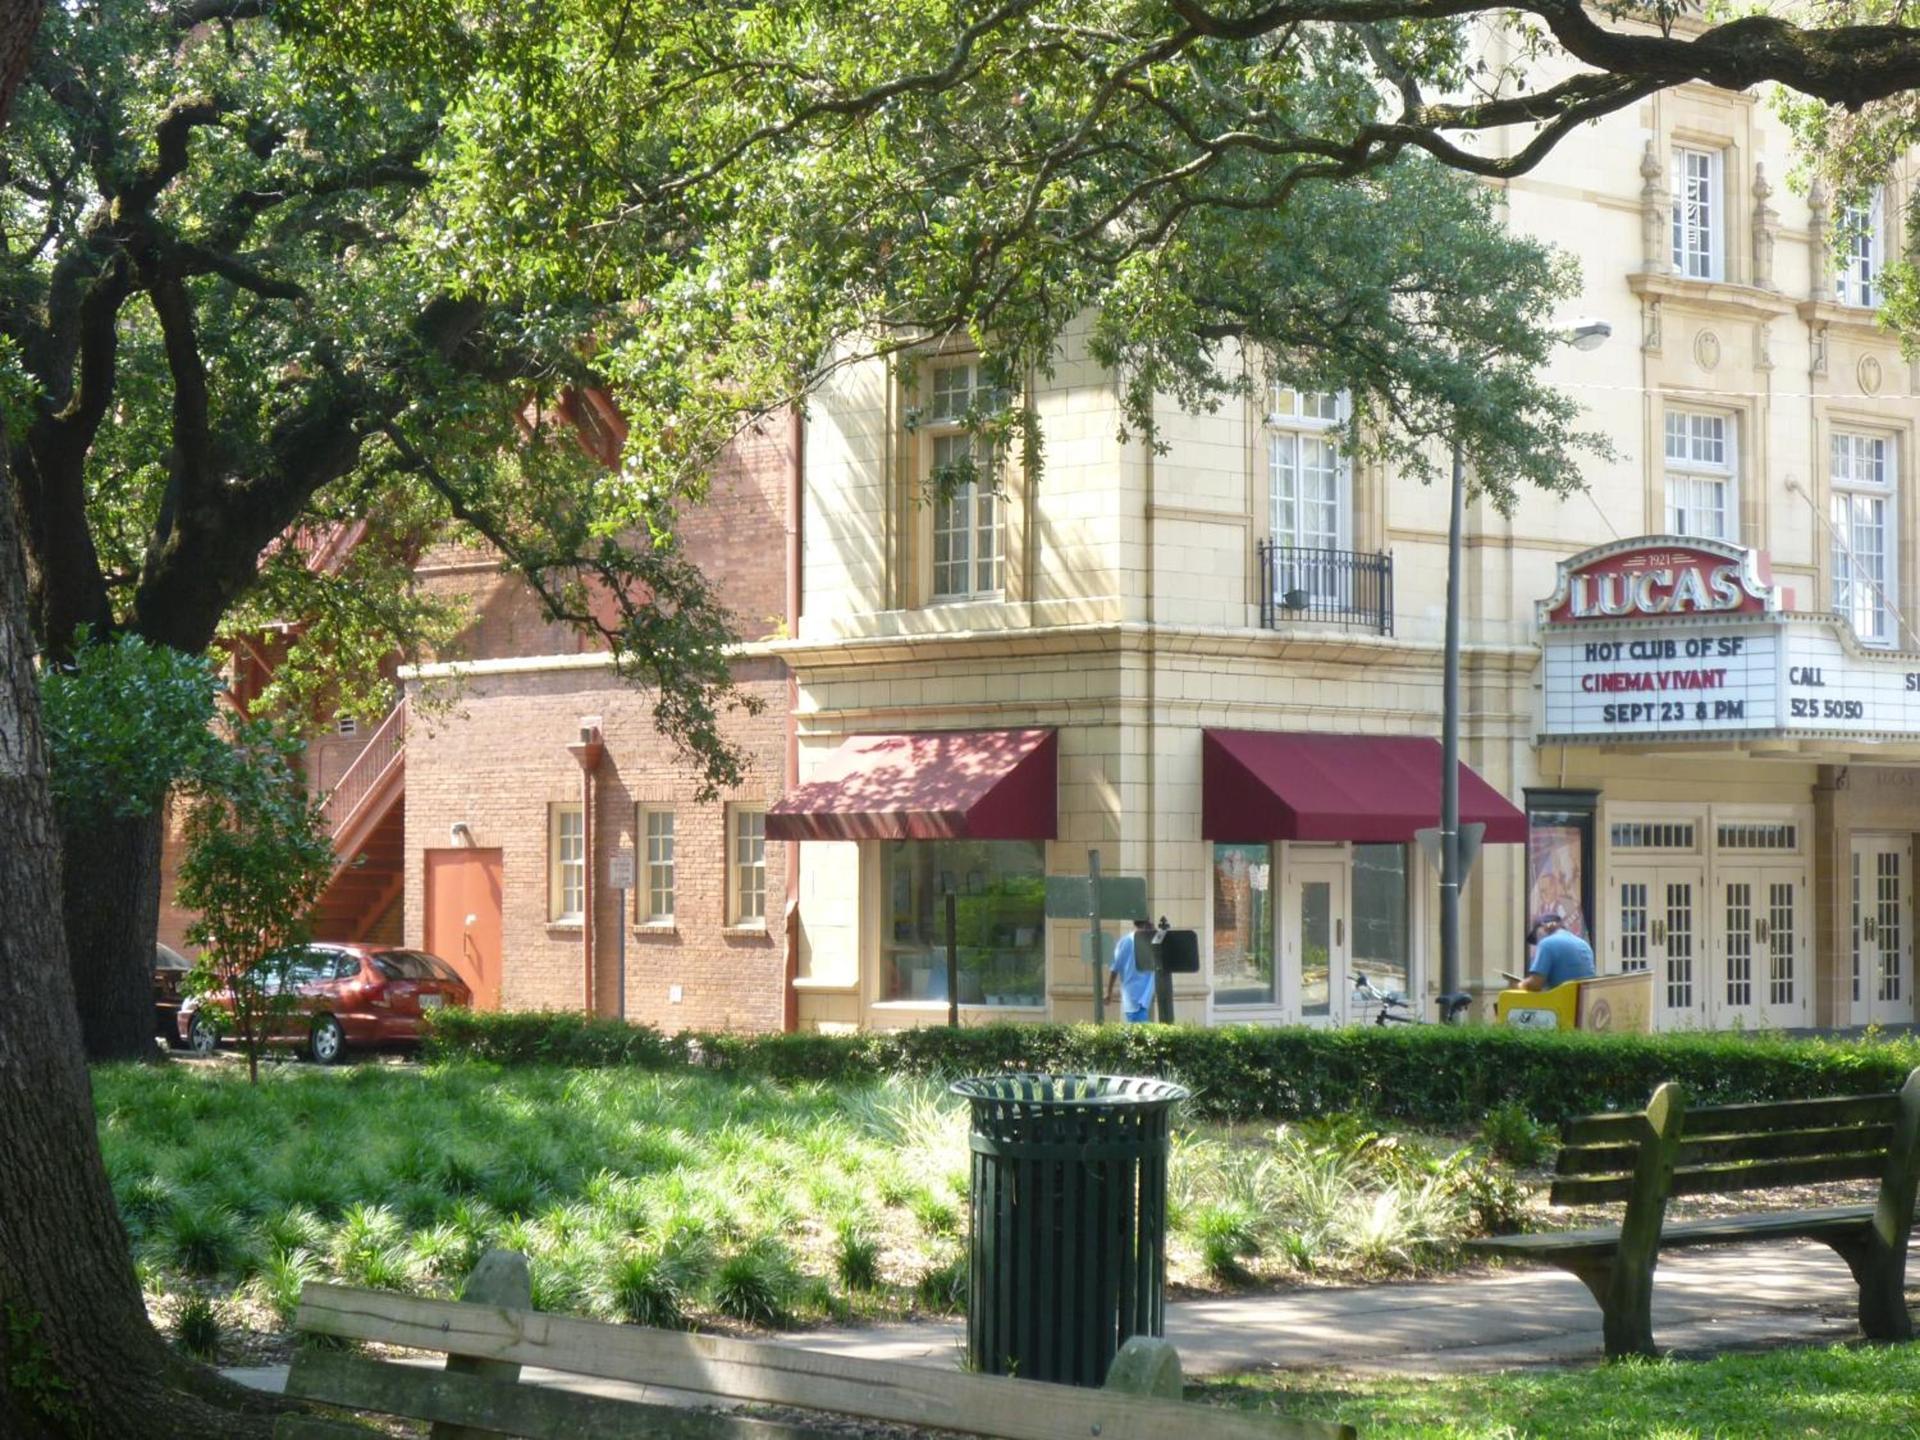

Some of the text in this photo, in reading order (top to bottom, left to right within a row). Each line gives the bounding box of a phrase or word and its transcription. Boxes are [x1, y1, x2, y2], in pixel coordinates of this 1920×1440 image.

[1648, 554, 1671, 566] 1921
[1569, 566, 1744, 618] LUCAS
[1585, 636, 1744, 662] HOT CLUB OF SF
[1581, 669, 1727, 693] CINEMA VIVANT
[1789, 666, 1825, 687] CALL
[1603, 700, 1744, 723] SEPT 23 8 PM
[1790, 698, 1863, 719] 525 5050
